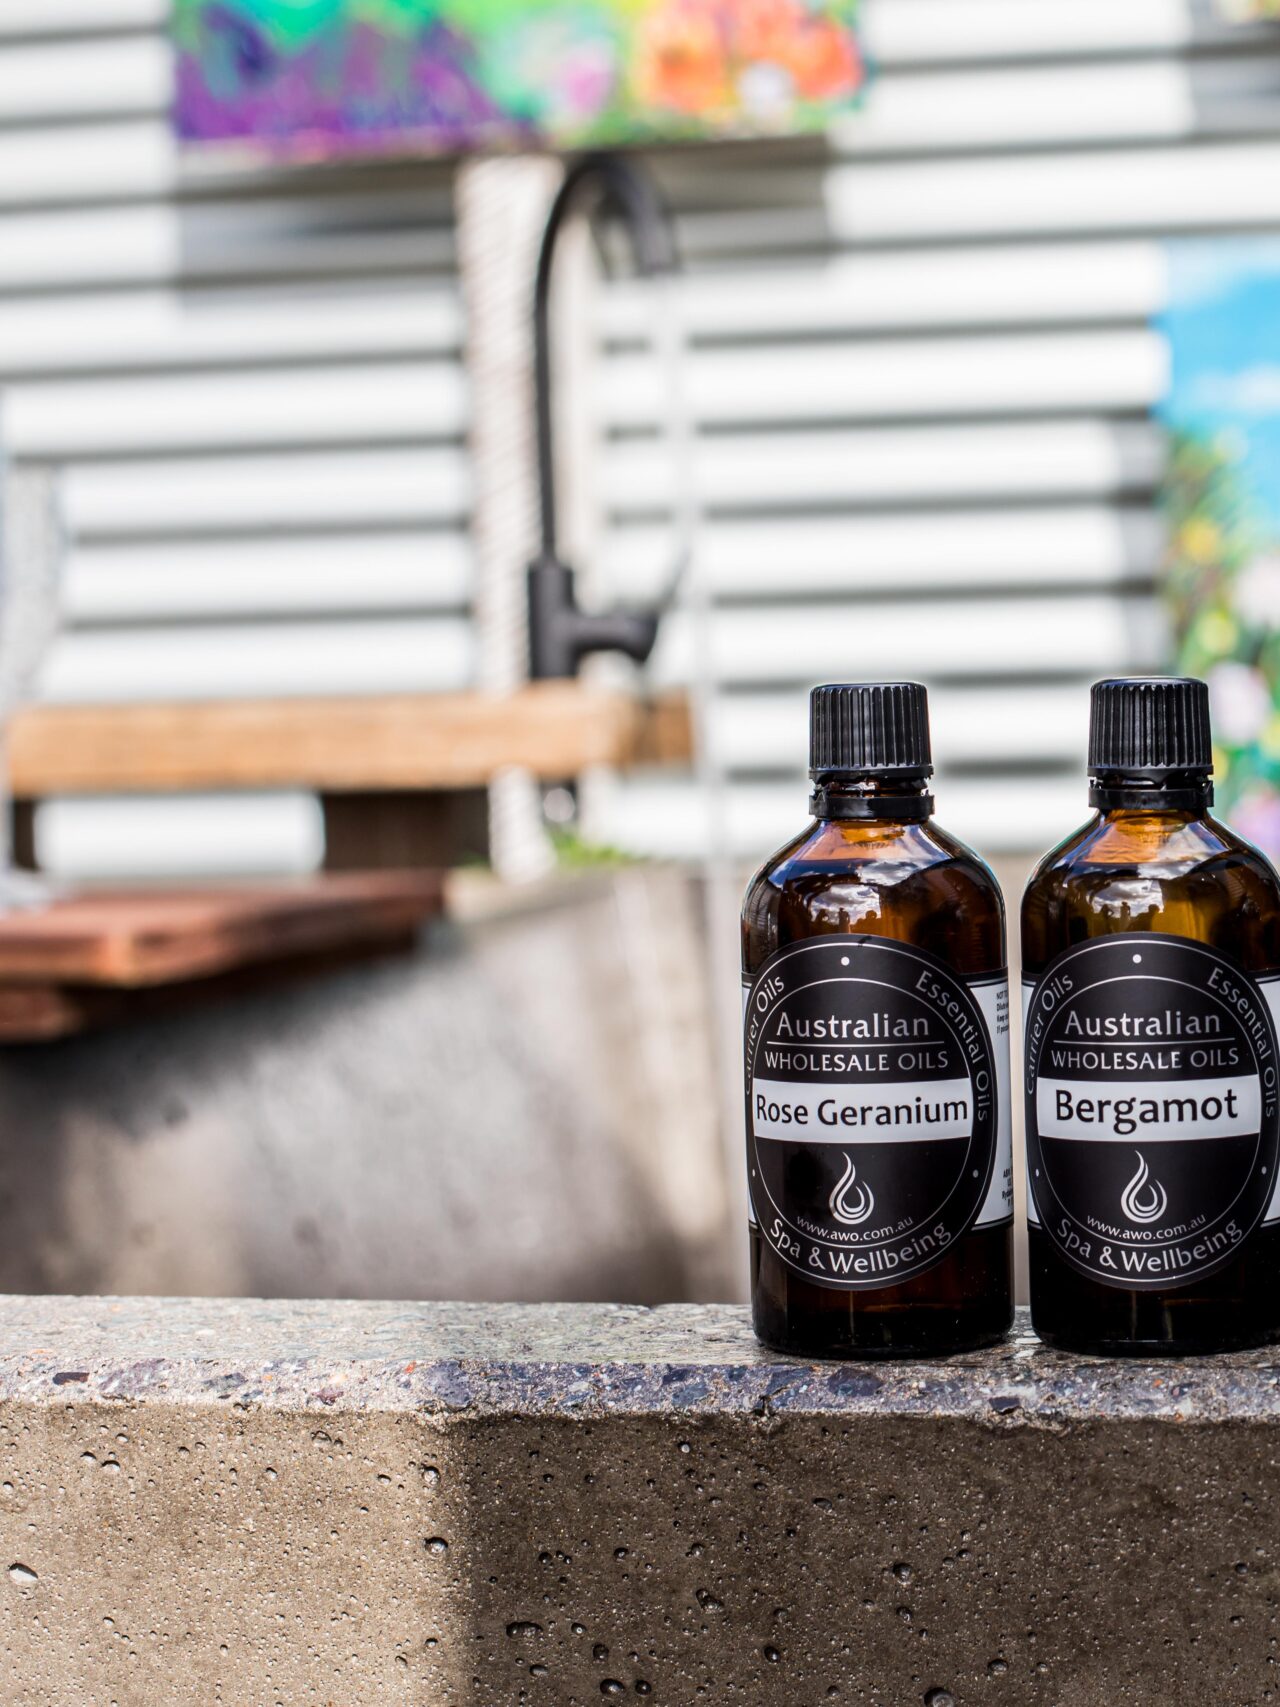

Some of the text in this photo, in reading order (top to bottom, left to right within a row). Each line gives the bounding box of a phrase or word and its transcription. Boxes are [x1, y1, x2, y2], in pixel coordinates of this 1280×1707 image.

[756, 976, 785, 1012] Oils
[776, 1012, 929, 1039] Australian
[915, 970, 986, 1064] Essential
[1064, 1010, 1221, 1037] Australian
[1206, 966, 1272, 1060] Essential
[1027, 973, 1074, 1095] Carrier Oils
[764, 1050, 949, 1072] WHOLESALE OILS
[1051, 1048, 1239, 1070] WHOLESALE OILS
[757, 1094, 968, 1126] Rose Geranium
[1055, 1089, 1238, 1136] Bergamot
[796, 1215, 914, 1243] www.awo.com.au
[1086, 1213, 1206, 1241] www.awo.com.au
[770, 1218, 952, 1274] Spa & Wellbeing
[1056, 1218, 1243, 1273] Spa & Wellbeing
